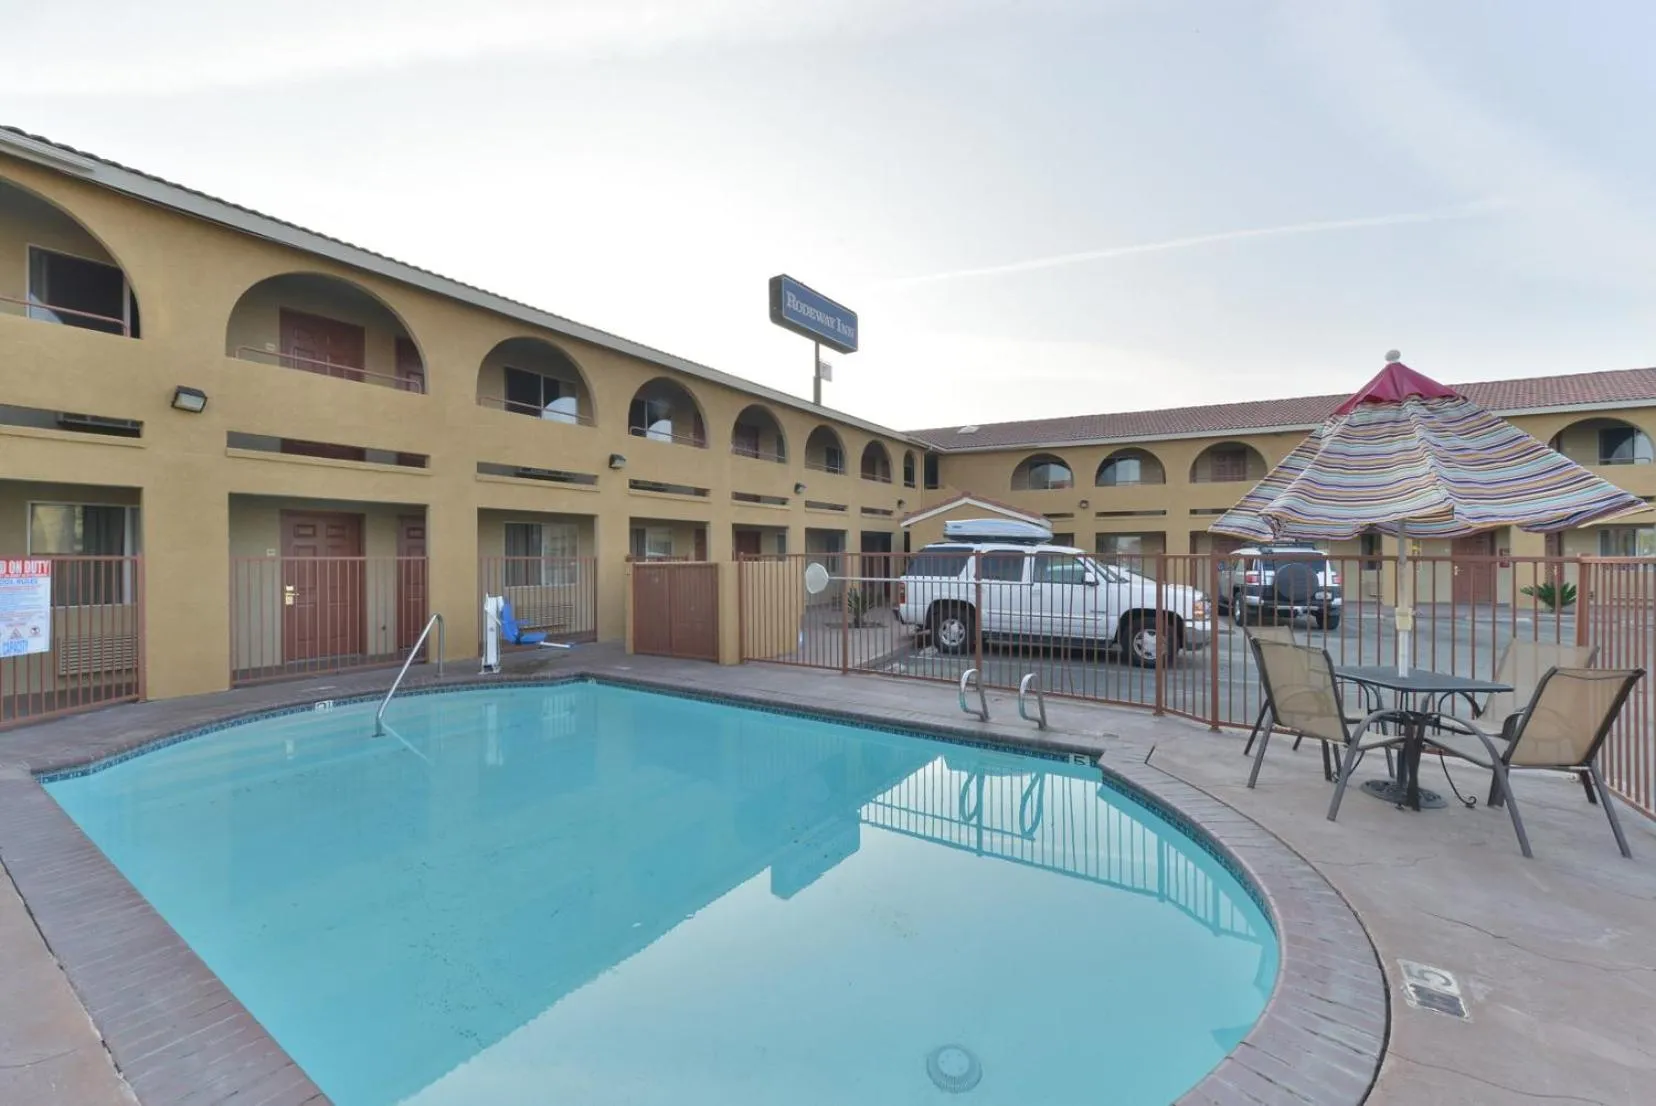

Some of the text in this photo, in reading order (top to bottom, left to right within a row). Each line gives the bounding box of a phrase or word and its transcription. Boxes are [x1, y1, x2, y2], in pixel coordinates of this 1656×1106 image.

[786, 291, 856, 339] RODEWAY INN
[9, 559, 23, 574] ON
[24, 559, 49, 574] DUTY
